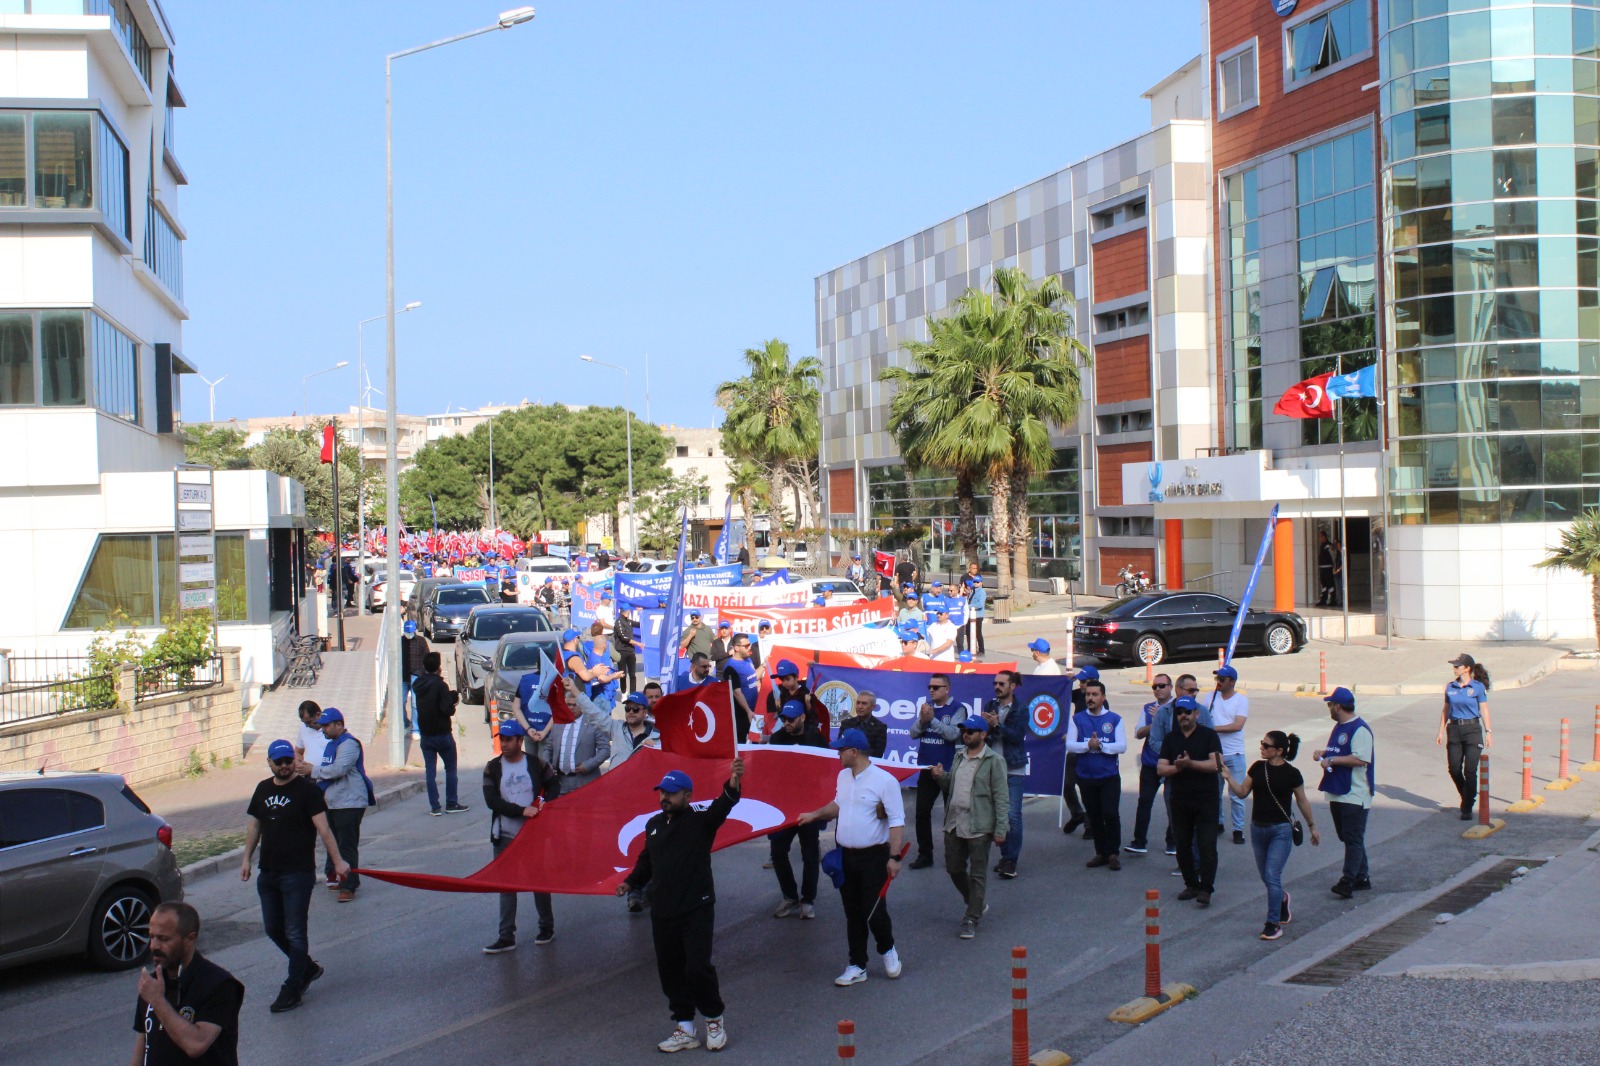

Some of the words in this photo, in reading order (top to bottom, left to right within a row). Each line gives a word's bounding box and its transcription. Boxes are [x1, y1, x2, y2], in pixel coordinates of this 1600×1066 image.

[713, 592, 745, 607] DEĞİL
[777, 617, 827, 635] YETER
[832, 608, 881, 631] SÖZÜN
[264, 795, 291, 808] ITALY
